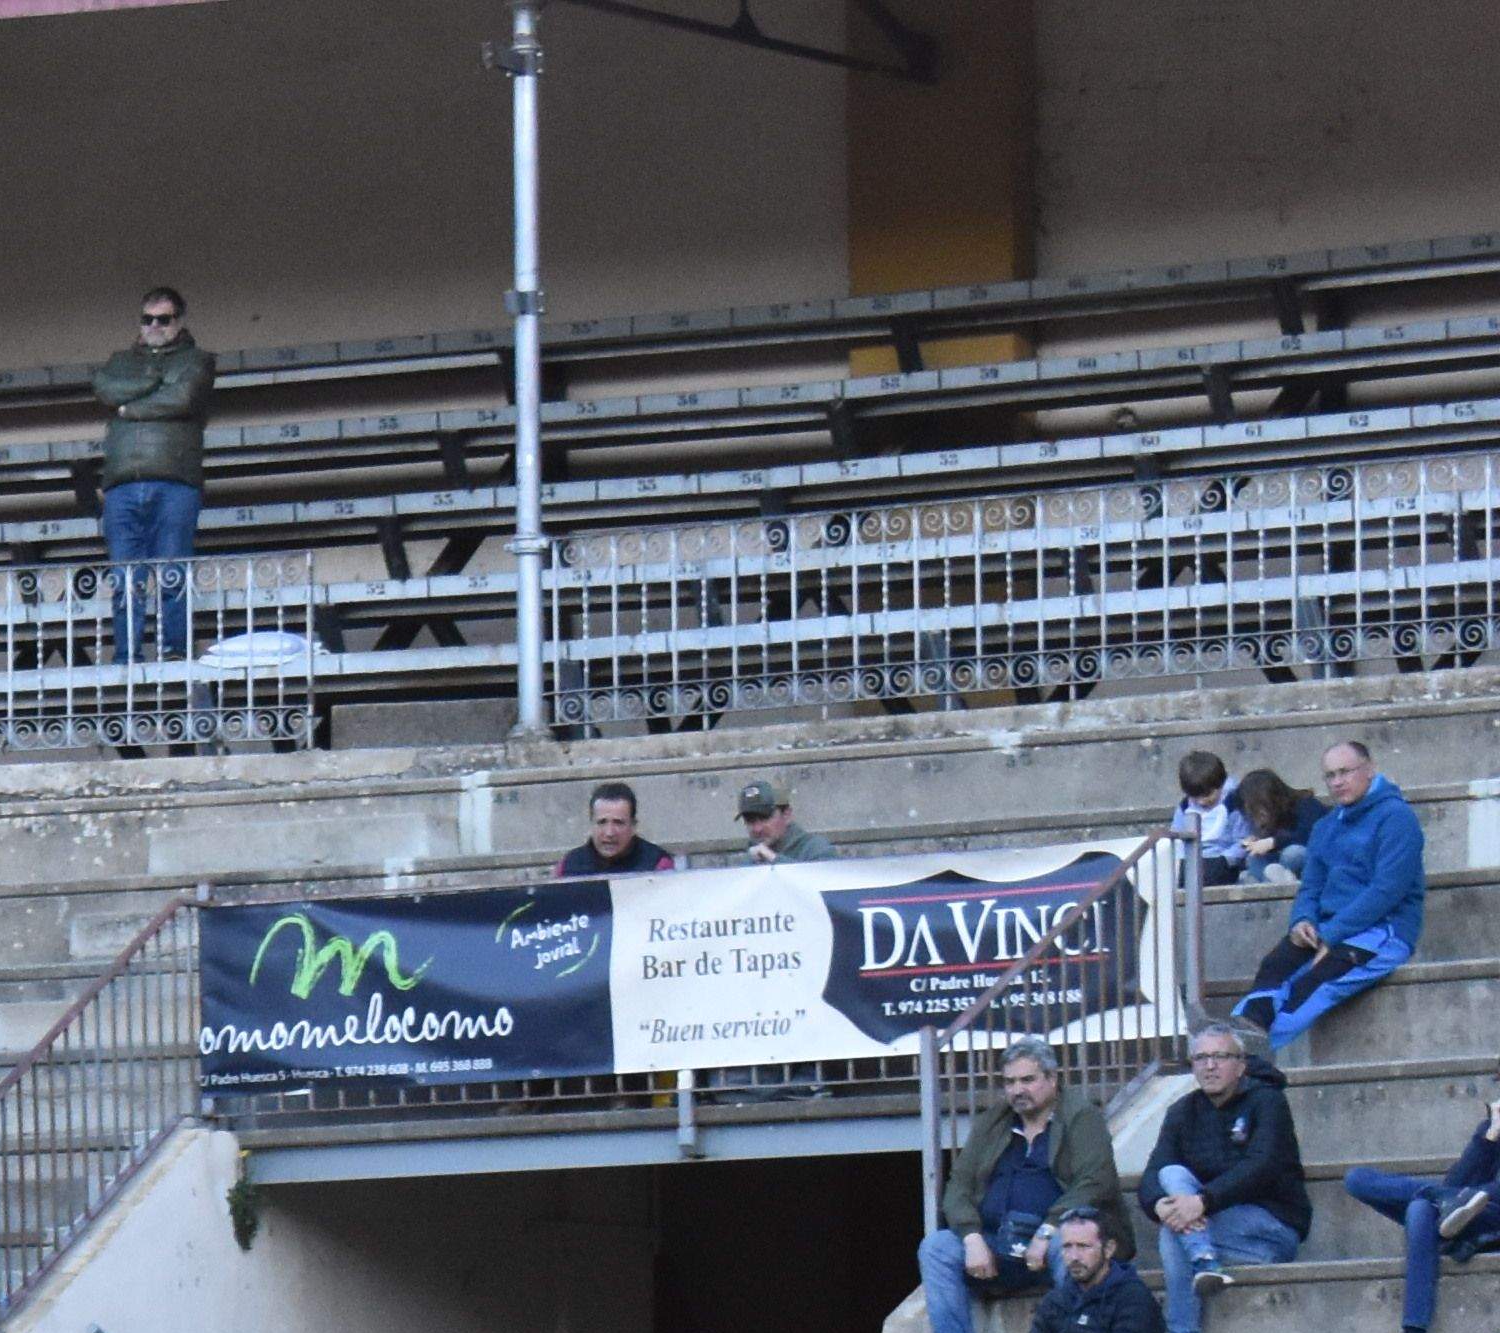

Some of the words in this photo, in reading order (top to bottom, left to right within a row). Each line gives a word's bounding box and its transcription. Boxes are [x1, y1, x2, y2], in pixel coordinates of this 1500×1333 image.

[648, 911, 795, 943] Restaurante
[642, 953, 685, 980] Bar
[695, 951, 722, 976] de
[730, 948, 802, 978] Tapas
